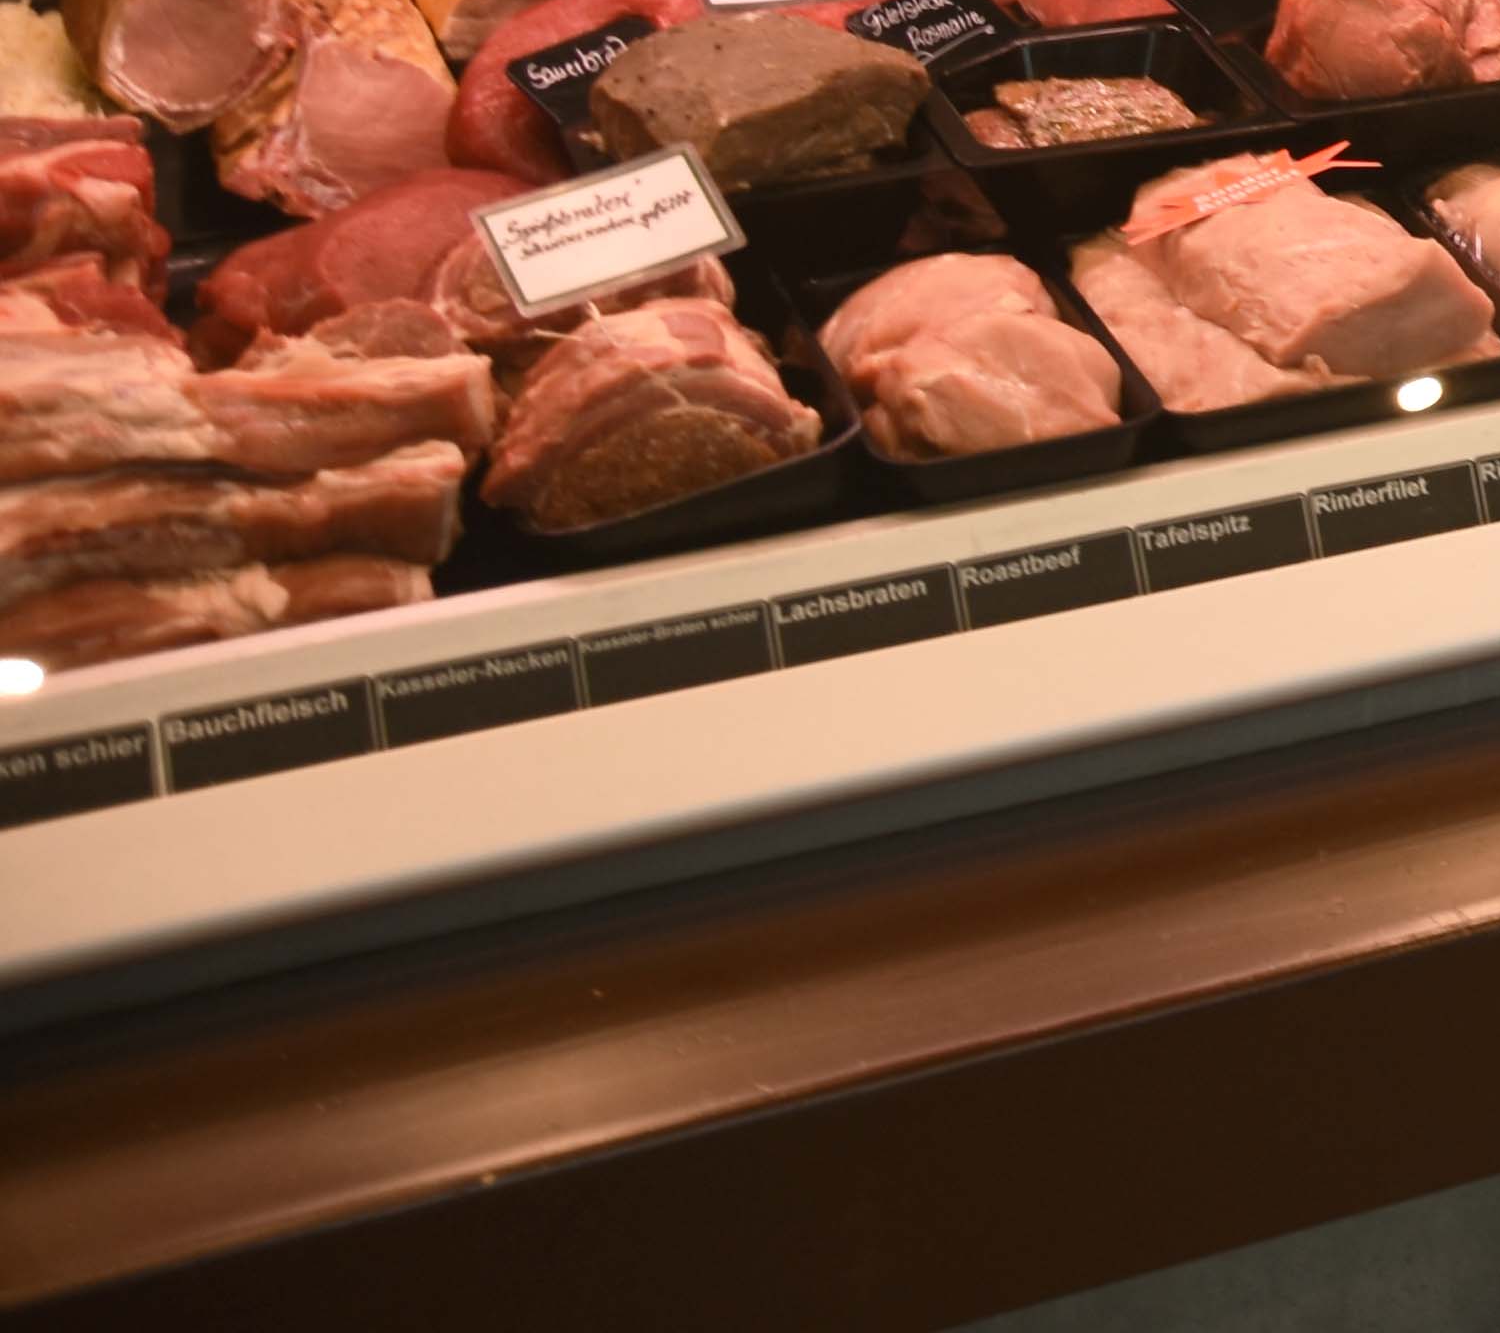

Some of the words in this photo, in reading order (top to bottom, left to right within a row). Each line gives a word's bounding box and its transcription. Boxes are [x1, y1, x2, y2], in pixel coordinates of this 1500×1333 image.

[1312, 476, 1431, 517] Rinderfilet
[1140, 513, 1252, 553] Tafelspitz
[959, 544, 1082, 589] Roastbeef
[775, 576, 928, 625] Lachsbraten
[379, 646, 571, 700] Kasseler-Nacken
[168, 691, 350, 745] Bauchfleisch
[53, 734, 146, 770] schier
